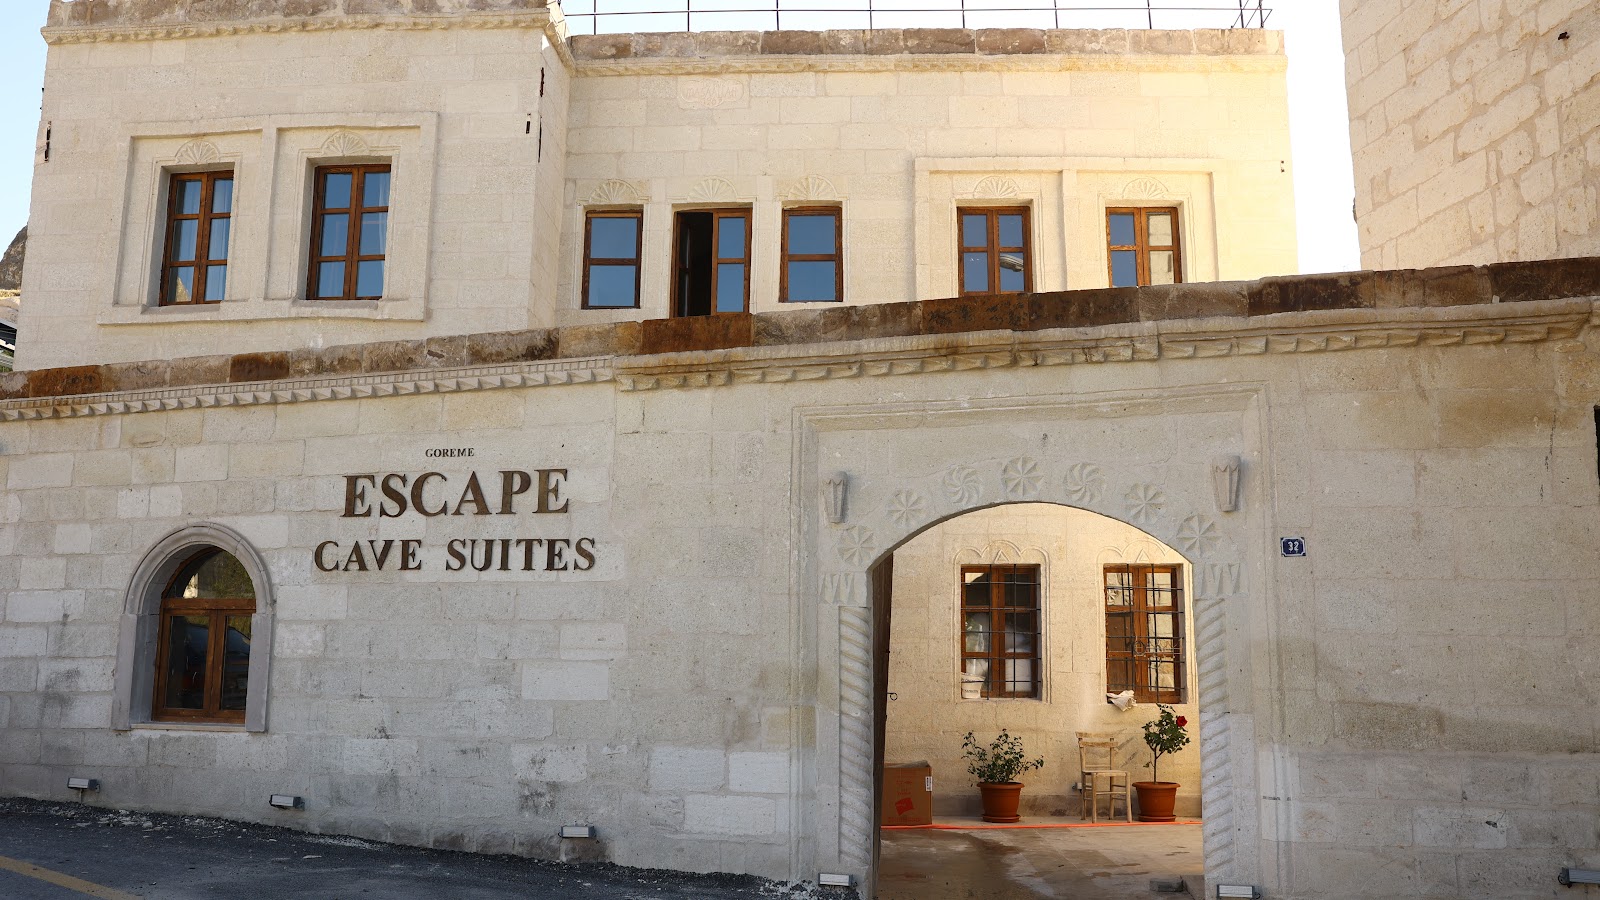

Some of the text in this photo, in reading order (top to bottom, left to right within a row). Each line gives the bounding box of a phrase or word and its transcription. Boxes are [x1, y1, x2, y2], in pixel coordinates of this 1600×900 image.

[425, 447, 475, 458] GOREME
[339, 468, 569, 518] ESCAPE
[313, 537, 596, 572] CAVE SUITES
[1287, 541, 1300, 551] 32
